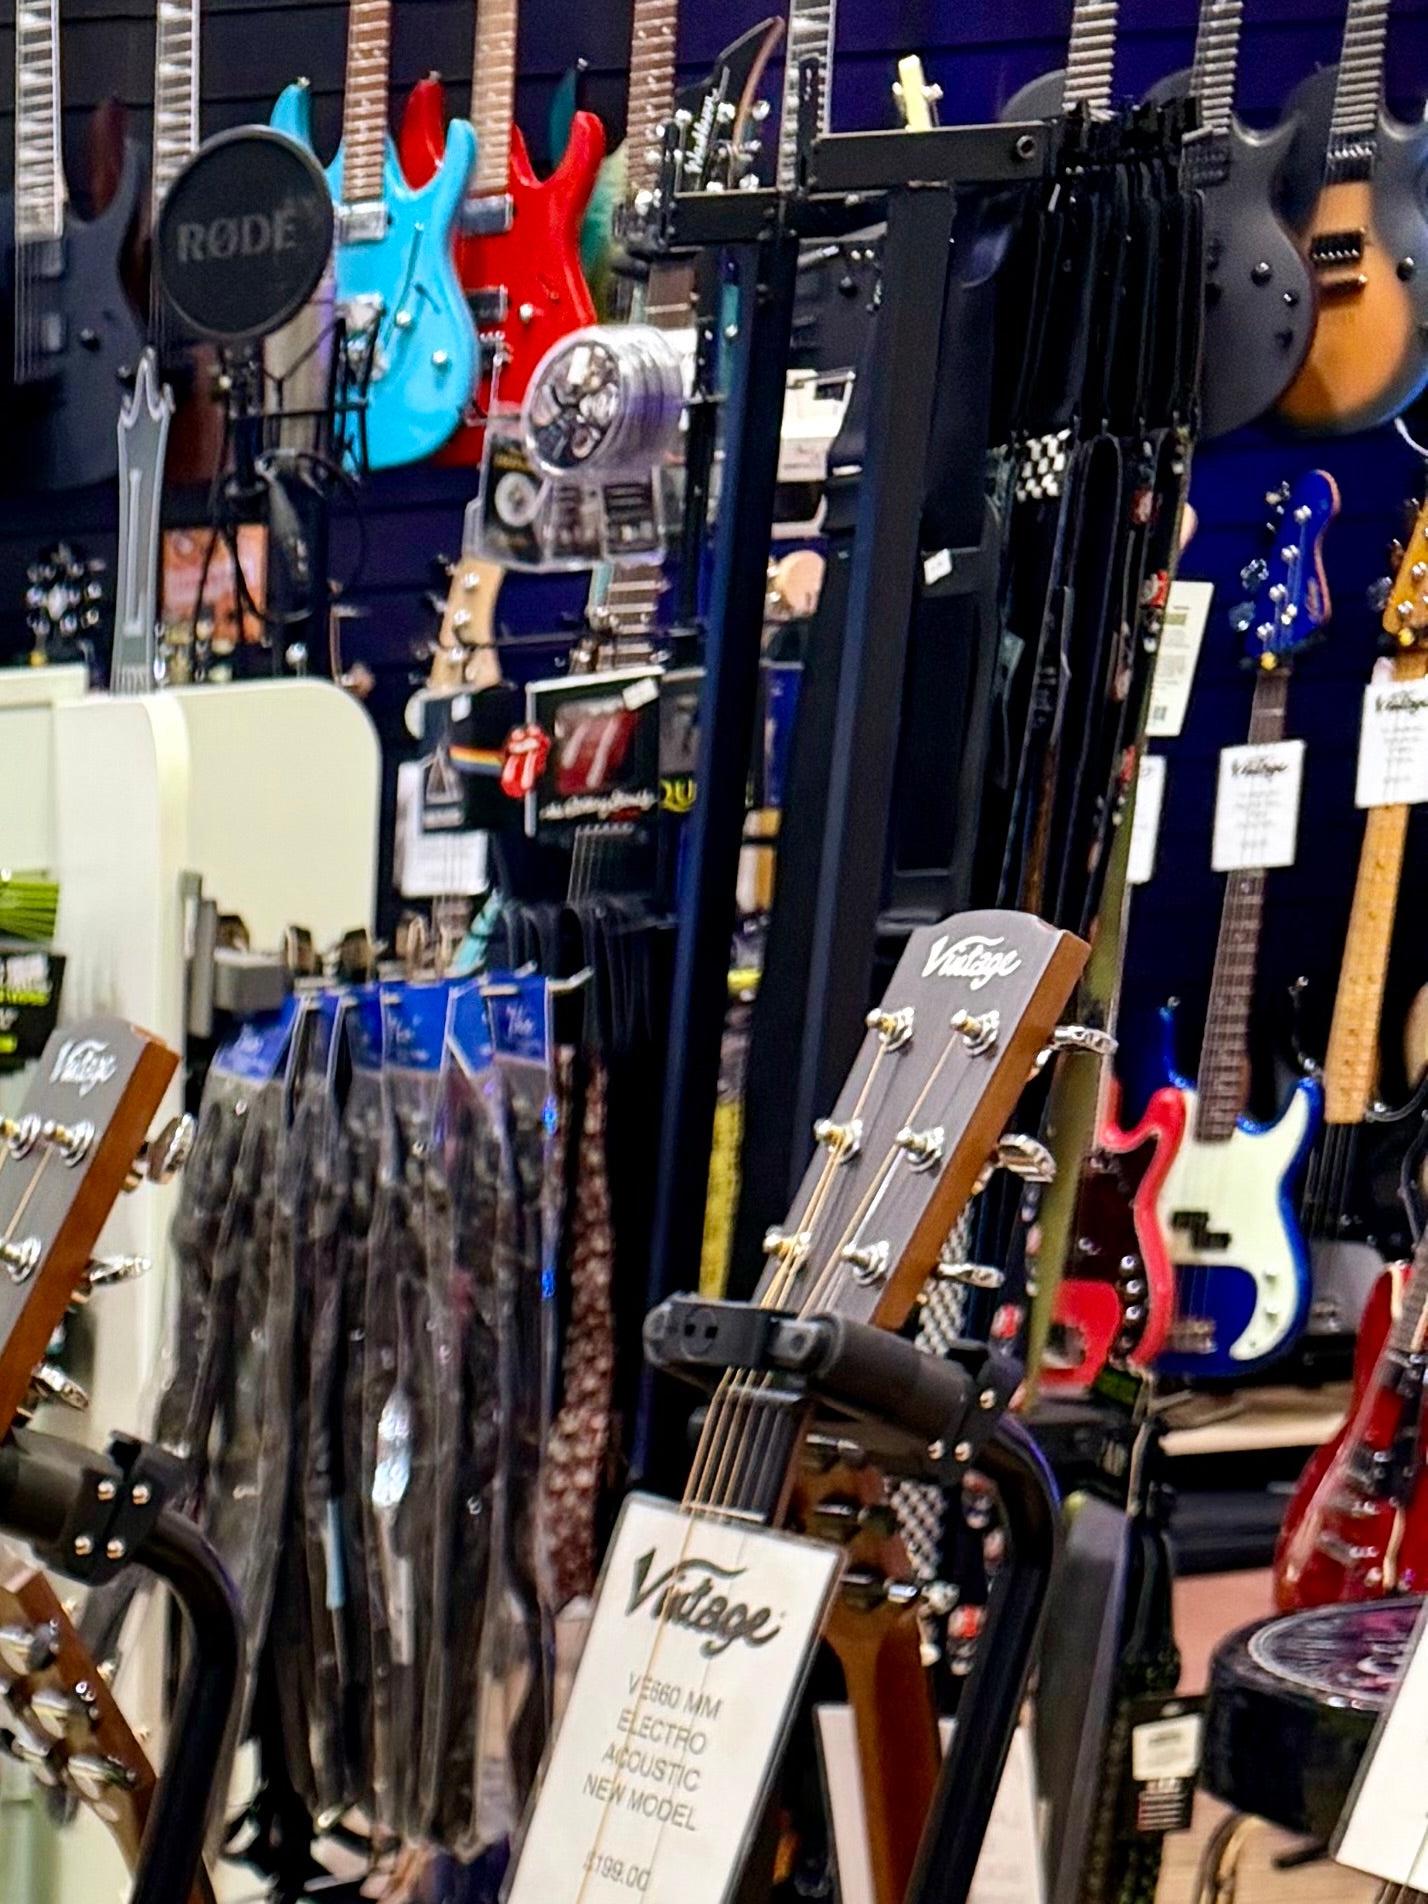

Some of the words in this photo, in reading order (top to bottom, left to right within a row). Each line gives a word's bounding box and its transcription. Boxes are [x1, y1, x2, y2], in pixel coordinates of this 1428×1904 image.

[921, 934, 1023, 991] Vintage
[49, 1038, 118, 1099] Vintage
[624, 1546, 782, 1658] Vintage
[616, 1708, 707, 1755] ELECTRO
[684, 1690, 723, 1722] MM
[601, 1743, 701, 1792] ACOUSTIC
[582, 1773, 624, 1806] NEW
[627, 1790, 698, 1832] MODEL
